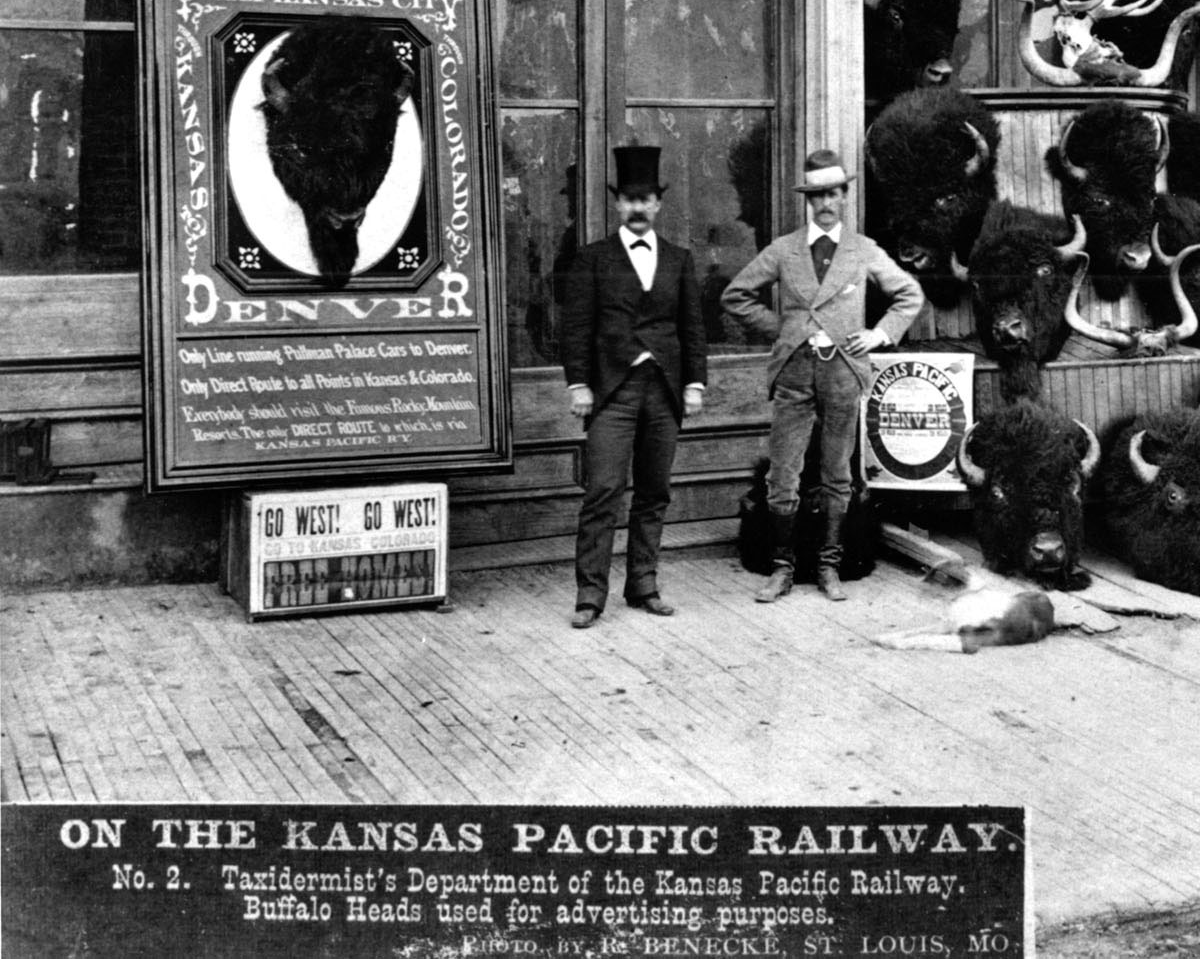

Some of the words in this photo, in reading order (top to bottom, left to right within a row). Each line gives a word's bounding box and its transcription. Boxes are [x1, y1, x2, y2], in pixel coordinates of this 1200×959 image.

[176, 50, 208, 210] KANSAS
[440, 56, 469, 231] COLORADO
[181, 264, 473, 326] DENVER
[178, 347, 206, 369] Only
[206, 347, 235, 363] Line
[236, 345, 284, 366] running
[282, 344, 335, 360] Pullman
[333, 343, 377, 359] Palace
[378, 342, 407, 357] Cars
[409, 342, 423, 356] to
[424, 340, 472, 356] Denver.
[180, 378, 209, 400] Only
[209, 377, 249, 394] Direct
[247, 376, 284, 394] Route
[284, 376, 299, 391] to
[299, 374, 316, 390] all
[314, 373, 351, 389] Points
[351, 372, 365, 387] in
[363, 371, 408, 387] Kansas
[408, 370, 420, 385] &
[419, 368, 477, 384] Colorado.
[871, 363, 908, 402] KANSAS
[912, 362, 958, 401] PACIFIC
[181, 404, 244, 426] Everybody
[248, 403, 288, 420] should
[290, 401, 320, 417] visit
[322, 401, 346, 416] the
[239, 425, 265, 439] The
[290, 422, 332, 437] DIRECT
[336, 420, 376, 435] ROUTE
[378, 422, 391, 433] to
[879, 412, 951, 429] DENVER
[255, 439, 321, 450] KANSAS
[326, 435, 381, 447] PACIFIC
[265, 508, 284, 537] GO
[296, 504, 340, 536] WEST!
[364, 501, 382, 531] GO
[393, 497, 436, 529] WEST!
[264, 542, 281, 556] GO
[288, 541, 305, 555] TO
[310, 537, 362, 553] KANSAS
[371, 531, 436, 548] COLORADO
[265, 558, 329, 607] FREE
